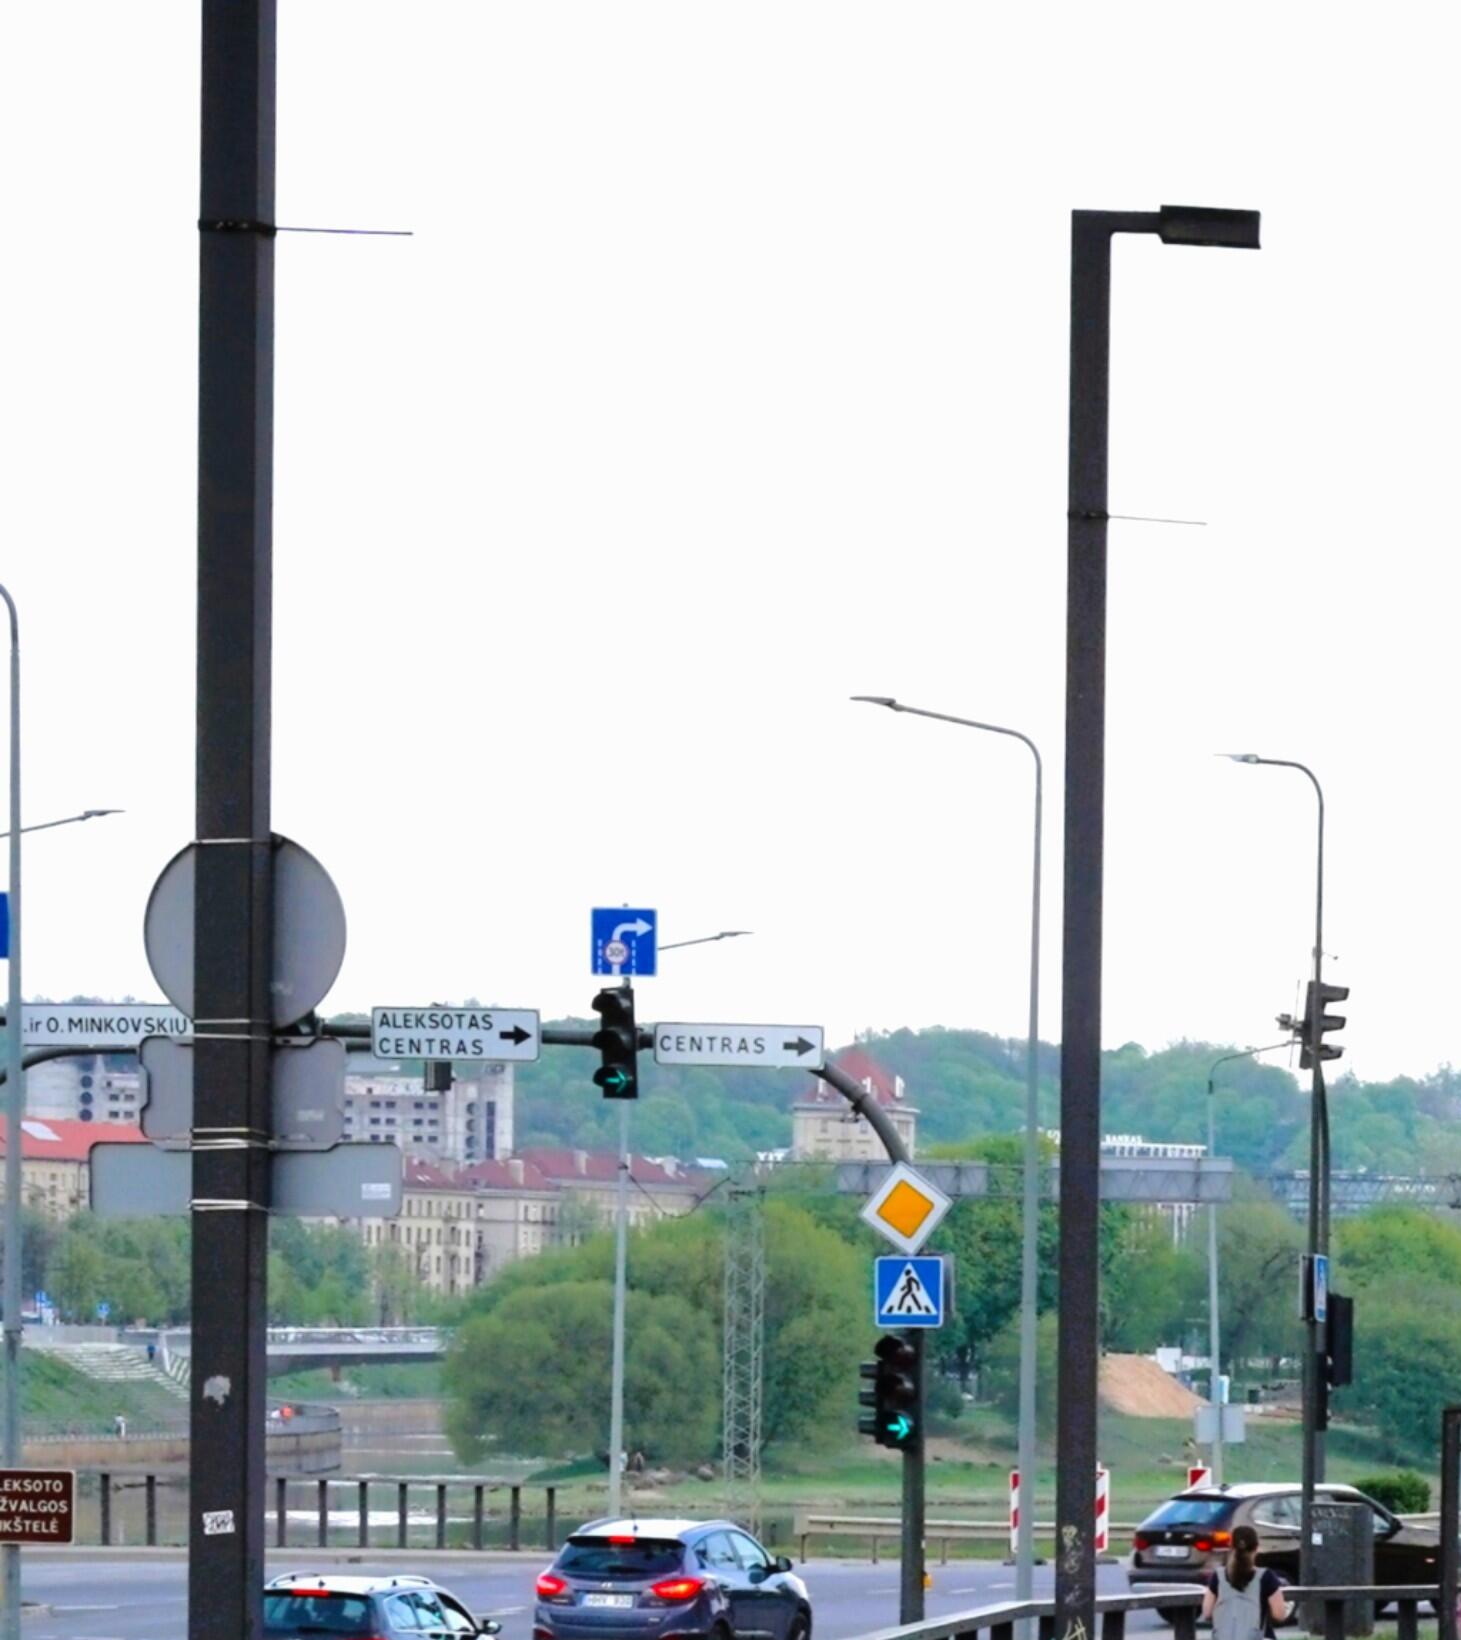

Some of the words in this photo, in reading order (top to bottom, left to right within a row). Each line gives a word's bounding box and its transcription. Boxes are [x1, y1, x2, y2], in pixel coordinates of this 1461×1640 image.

[379, 1012, 494, 1030] ALEKSOTAS
[378, 1037, 484, 1056] CENTRAS
[659, 1035, 766, 1055] CENTRAS
